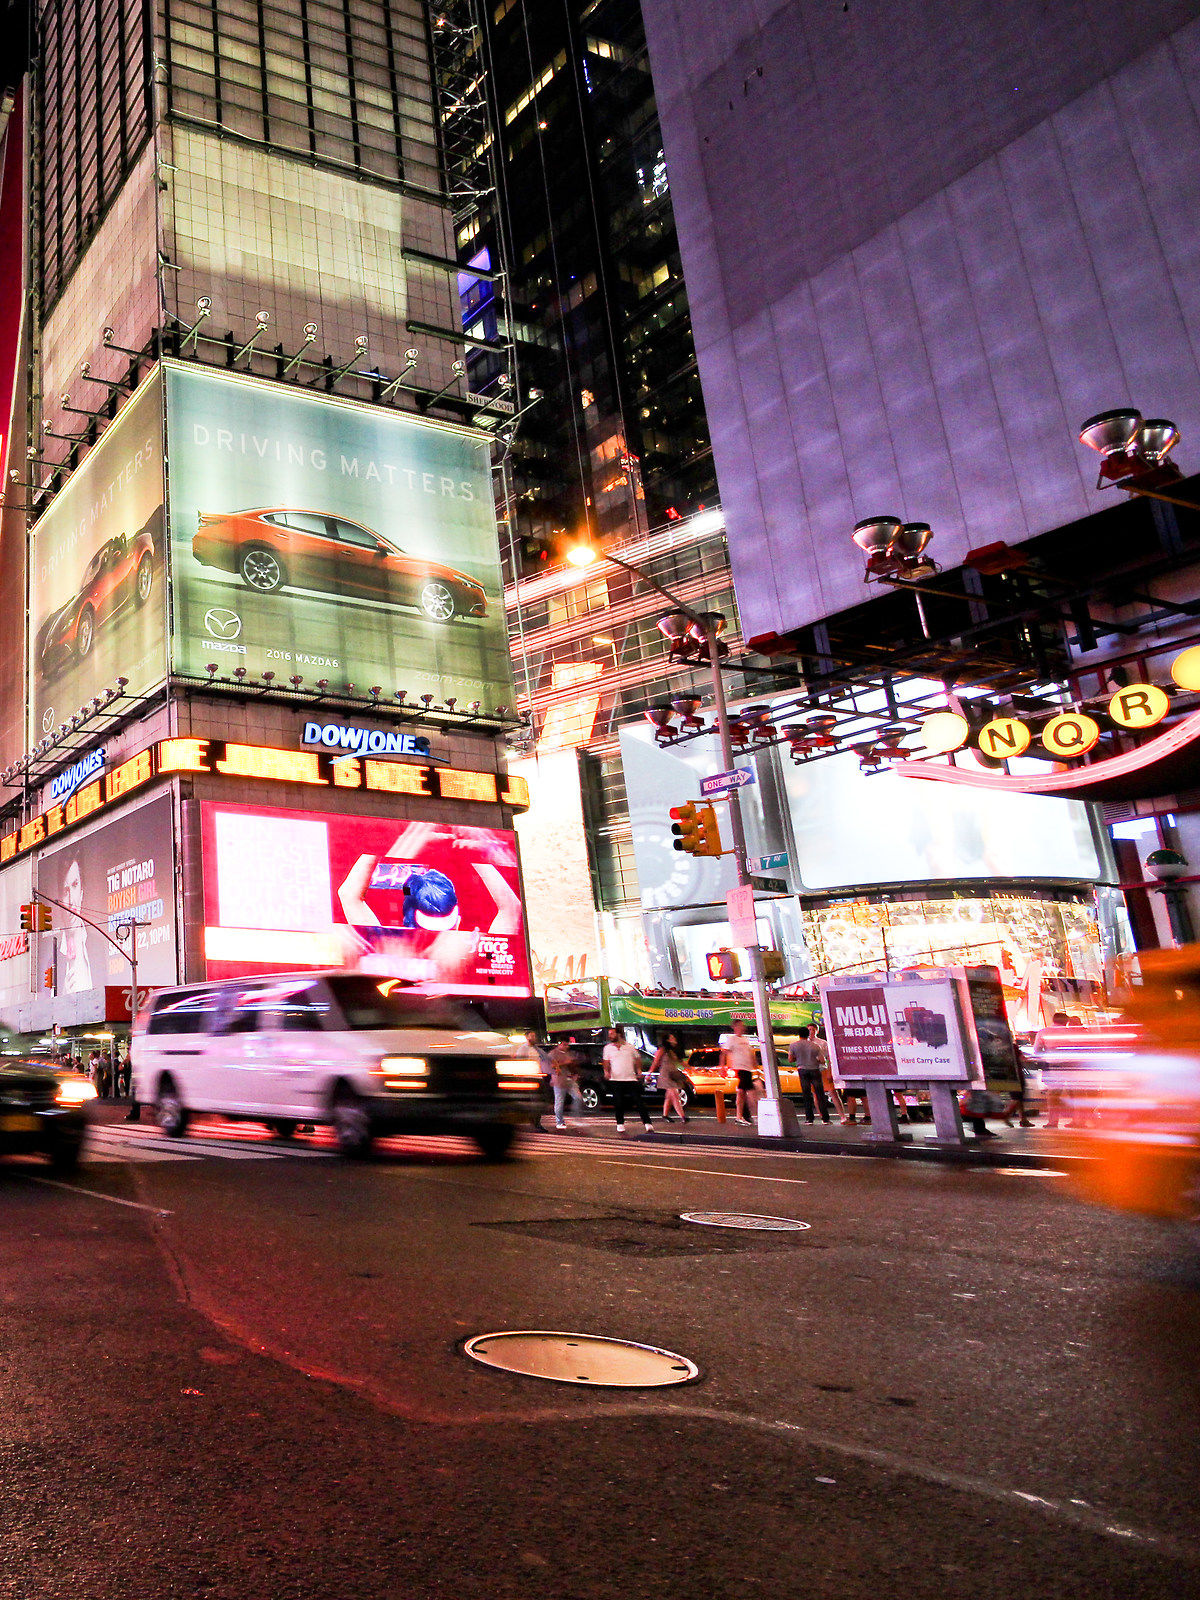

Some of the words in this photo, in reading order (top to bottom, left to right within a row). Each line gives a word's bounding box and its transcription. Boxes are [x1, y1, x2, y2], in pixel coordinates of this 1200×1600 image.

[193, 423, 327, 470] DRIVING
[341, 455, 474, 501] MATTERS
[40, 517, 87, 584] DRIVING
[89, 437, 154, 527] MATTERS
[201, 639, 247, 655] mazda
[266, 648, 292, 661] 2016
[295, 654, 339, 668] MAZDA6
[987, 723, 1017, 752] N
[1052, 720, 1084, 747] Q
[1118, 691, 1153, 721] R
[707, 779, 723, 790] ONE
[729, 772, 746, 784] WAY
[762, 856, 771, 869] 7
[106, 873, 120, 894] TIG
[121, 859, 155, 888] NOTARO
[107, 886, 137, 913] BOYISH
[137, 879, 158, 902] GIRL
[149, 924, 170, 947] 10PM
[664, 1008, 714, 1019] 888-680-4669
[835, 1004, 888, 1027] MUJI
[844, 1026, 884, 1037] 無印良品
[841, 1046, 862, 1054] TIMES
[864, 1045, 892, 1053] SQUARE
[916, 1057, 933, 1065] Carry
